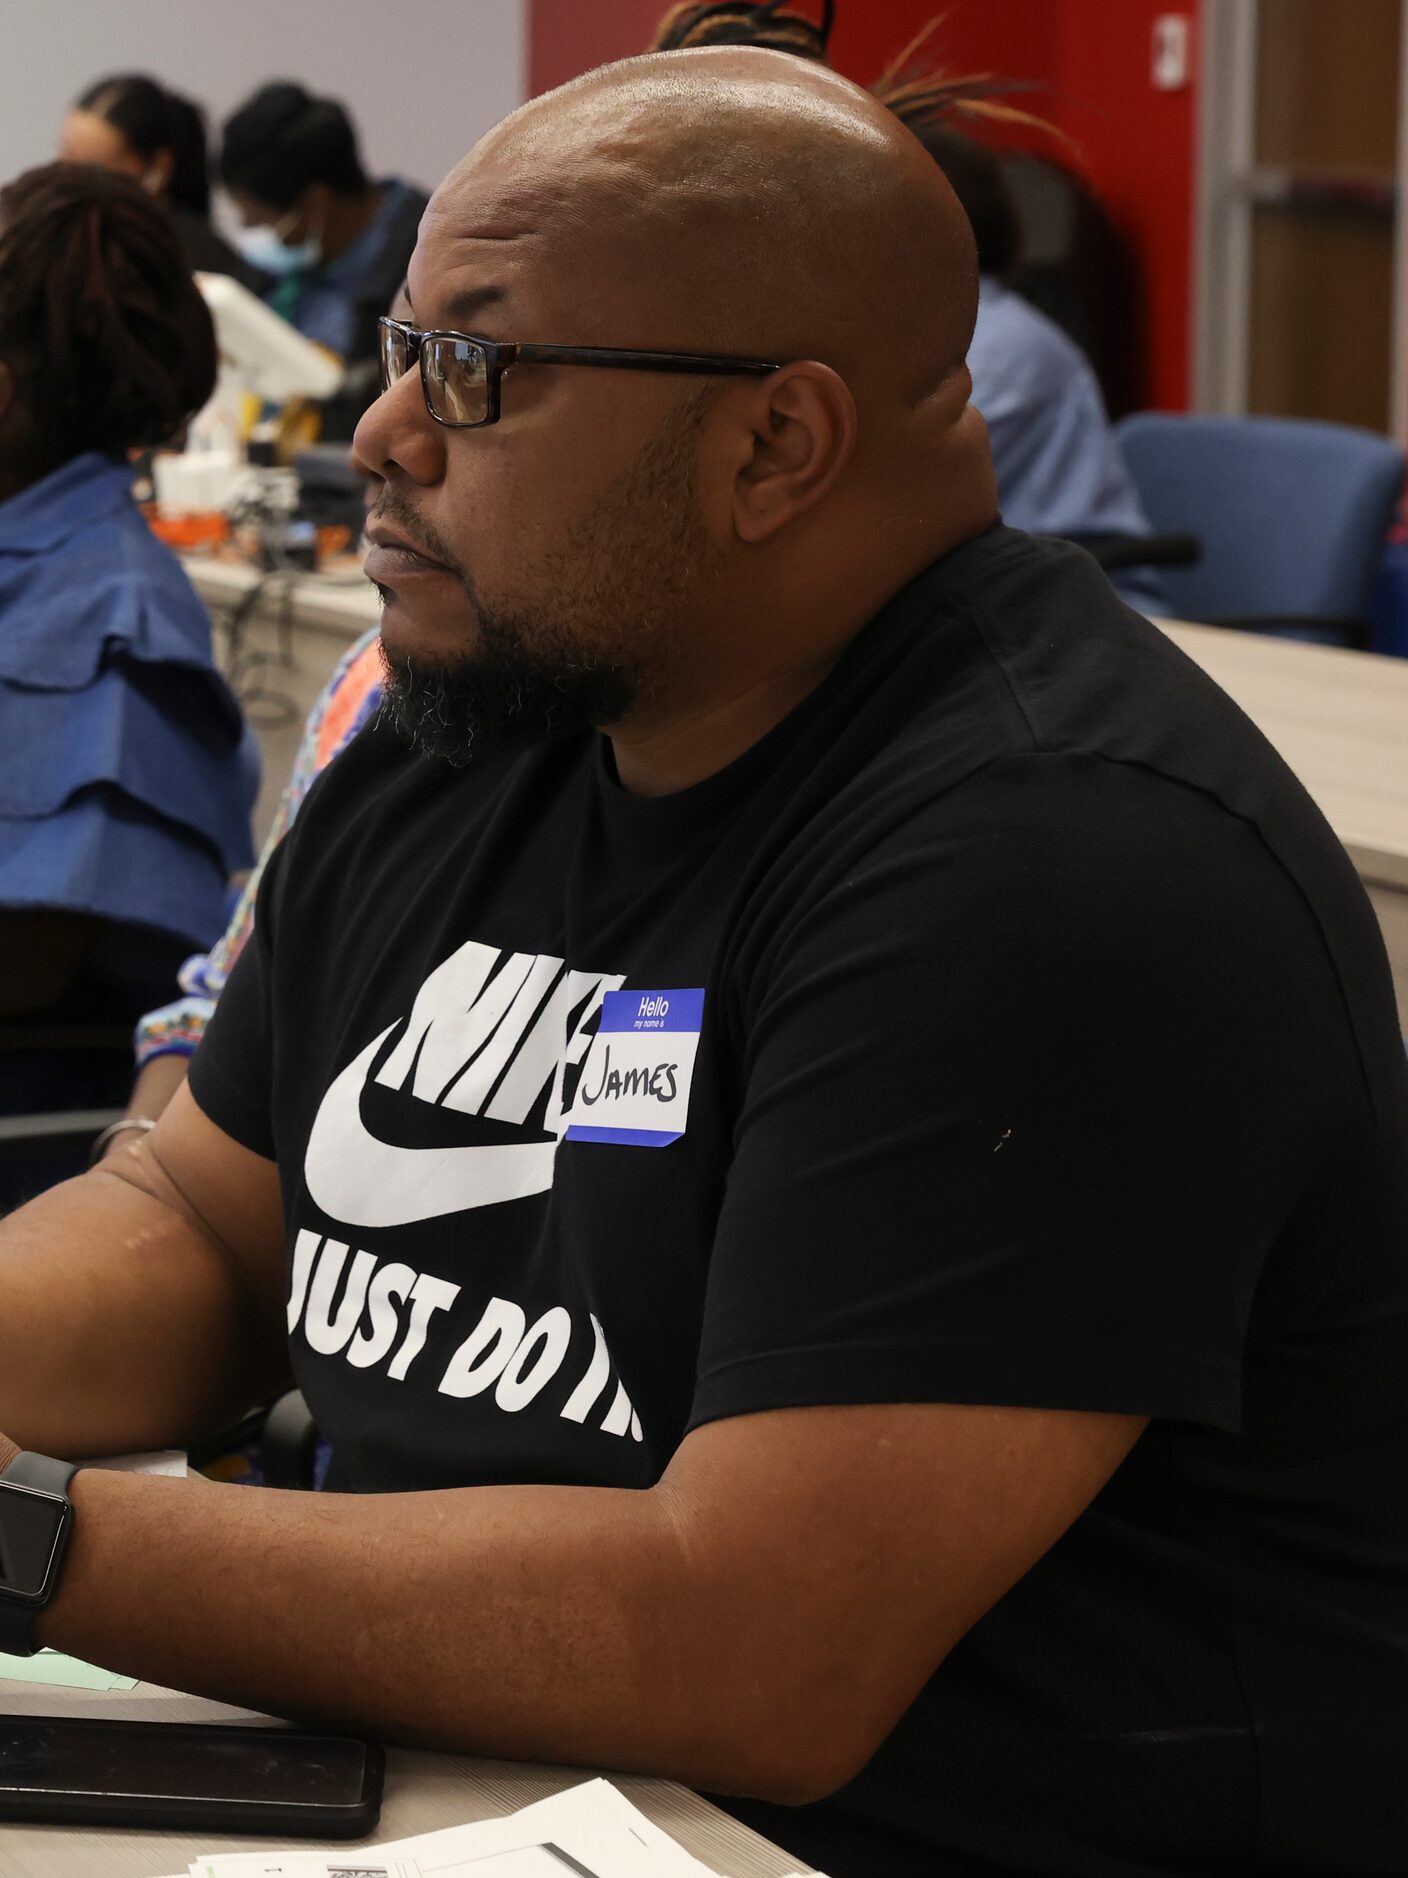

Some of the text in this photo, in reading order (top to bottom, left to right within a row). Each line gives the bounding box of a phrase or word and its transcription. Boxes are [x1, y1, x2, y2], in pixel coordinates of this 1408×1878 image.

[634, 1019, 665, 1030] my name is
[638, 996, 670, 1017] Hello
[581, 1044, 678, 1106] JAMES
[286, 1228, 462, 1381] JUST
[438, 1297, 572, 1413] DO
